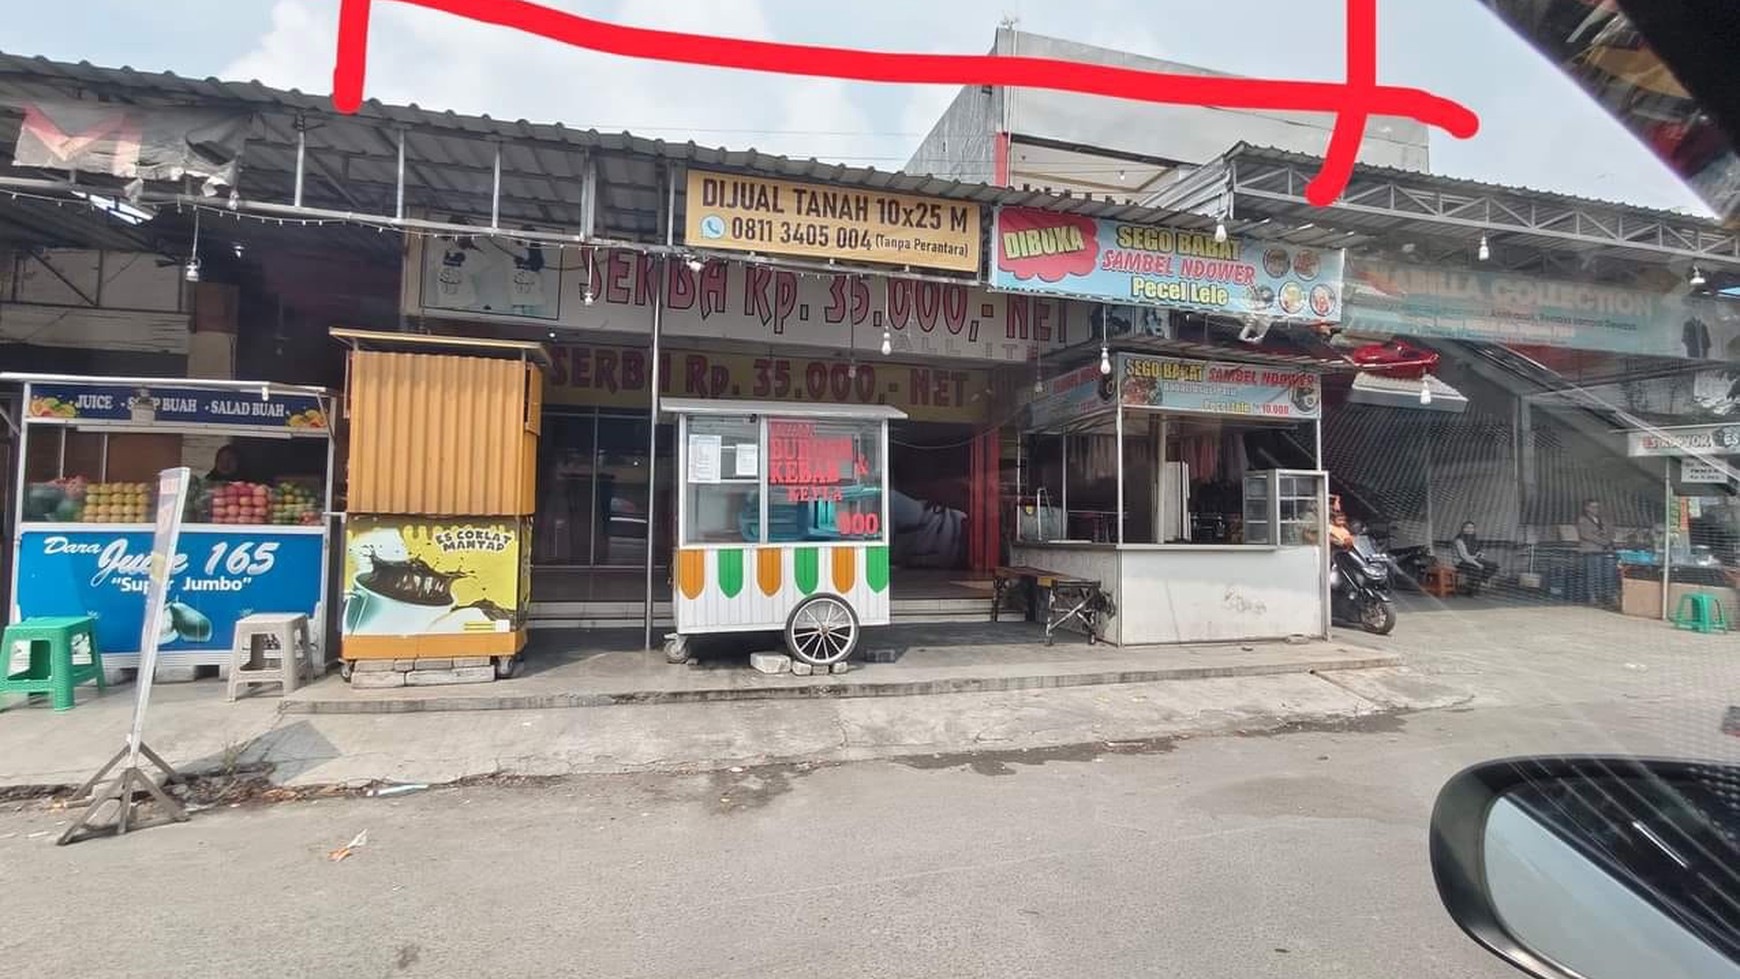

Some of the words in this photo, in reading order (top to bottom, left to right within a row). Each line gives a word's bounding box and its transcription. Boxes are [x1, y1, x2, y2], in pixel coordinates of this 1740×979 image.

[702, 178, 785, 214] DIJUAL
[793, 188, 869, 222] TANAH
[876, 199, 942, 230] 10x25
[950, 207, 968, 233] M
[732, 216, 773, 243] 0811
[780, 221, 829, 247] 3405
[836, 227, 872, 250] 004
[875, 233, 911, 250] (Tanpa
[913, 238, 969, 256] Perantara)
[1002, 225, 1085, 260] DIBUKA
[1117, 225, 1174, 254] SEGO
[1101, 250, 1175, 278] SAMBEL
[1180, 259, 1257, 286] NDOWER
[1131, 277, 1187, 302] Pecel
[1189, 284, 1229, 307] Lele
[1126, 358, 1161, 378] SEGO
[1208, 368, 1258, 384] SAMBEL
[909, 368, 969, 407] NET
[74, 394, 113, 411] JUICE
[162, 397, 198, 414] BUAH
[210, 400, 250, 417] SALAD
[251, 402, 285, 418] BUAH
[43, 536, 102, 555] Dara
[442, 540, 506, 553] MANTAP
[456, 530, 512, 545] COKLAT
[204, 541, 281, 576] 165
